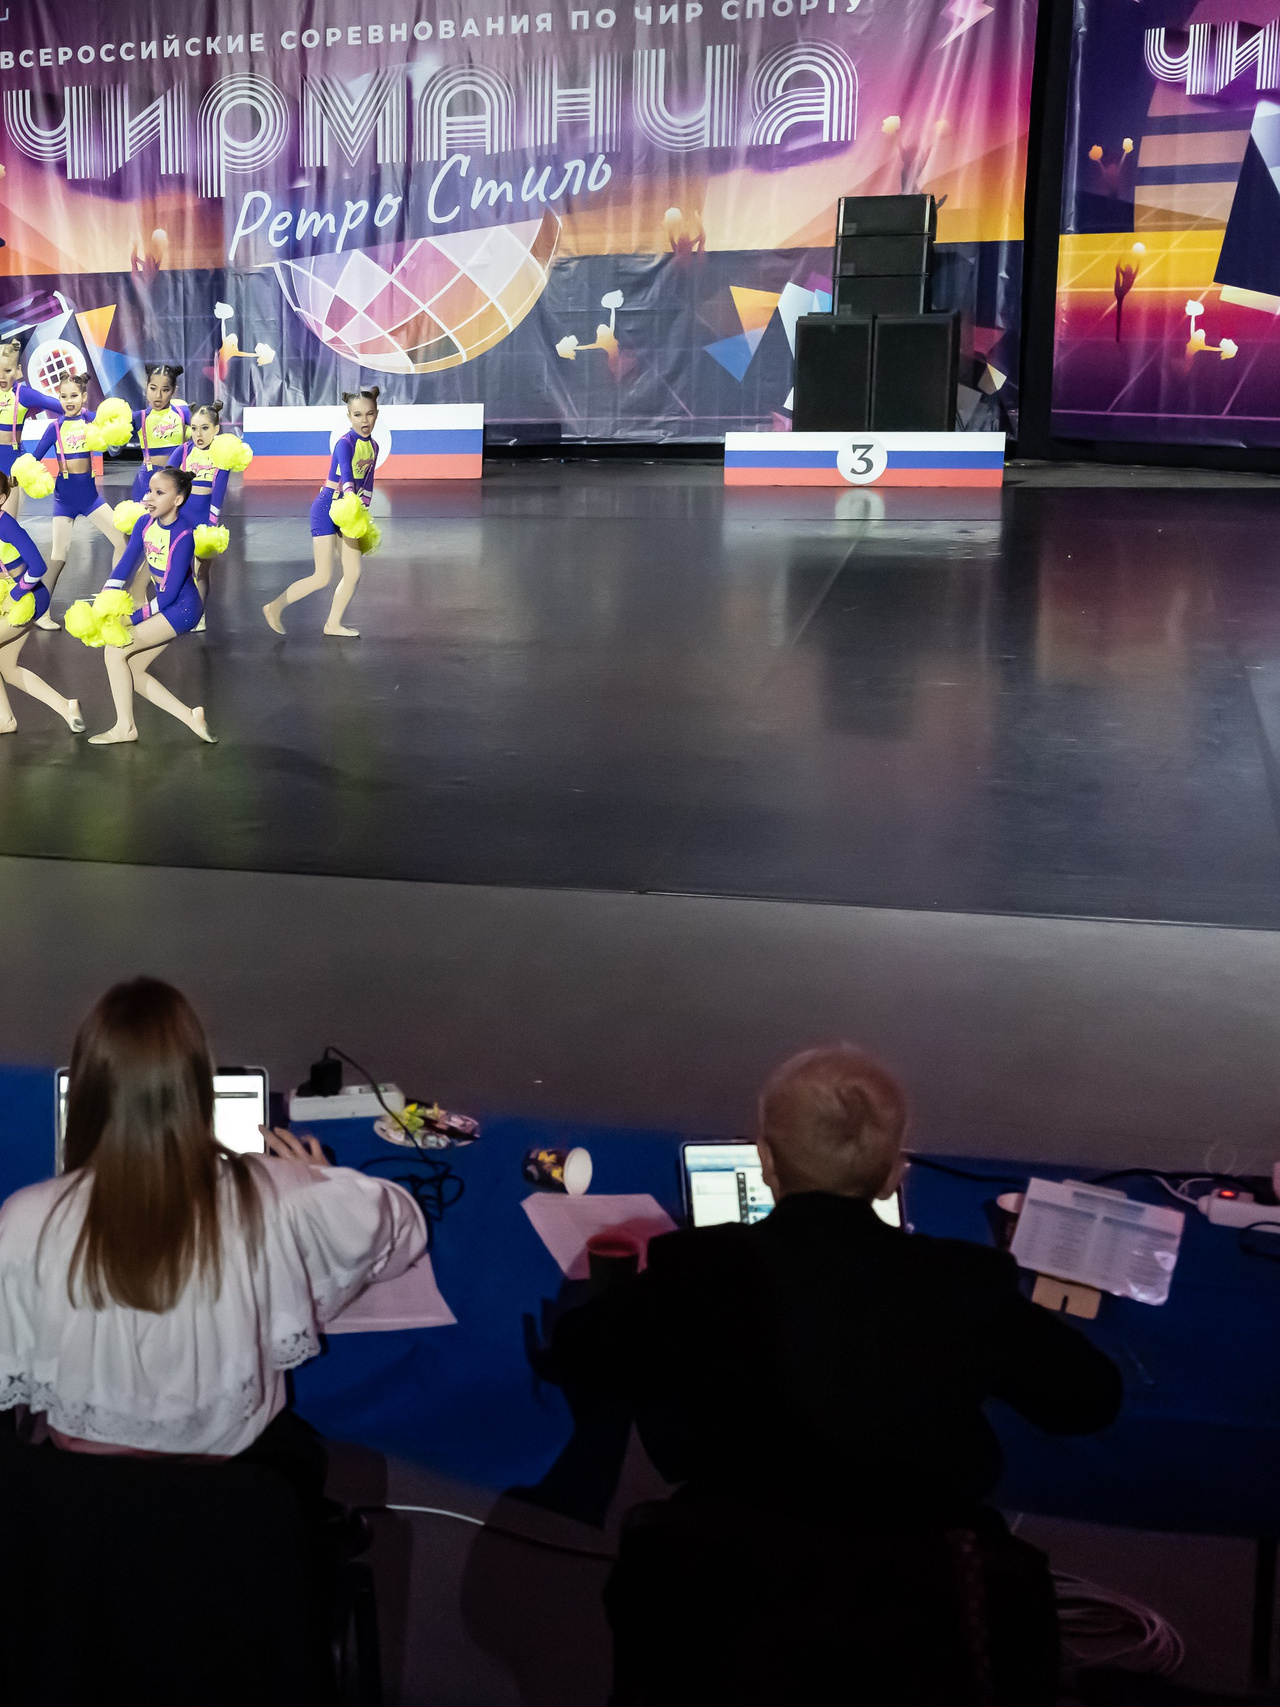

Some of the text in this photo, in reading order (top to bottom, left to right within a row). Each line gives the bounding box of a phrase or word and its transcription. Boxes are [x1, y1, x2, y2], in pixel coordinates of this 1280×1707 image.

[0, 0, 859, 70] ВСЕРОССИЙСКИЕ СОРЕВНОВАНИЯ ПО ЧИР СПОРТУ
[228, 153, 613, 262] Ретро Стиль
[850, 444, 874, 475] 3
